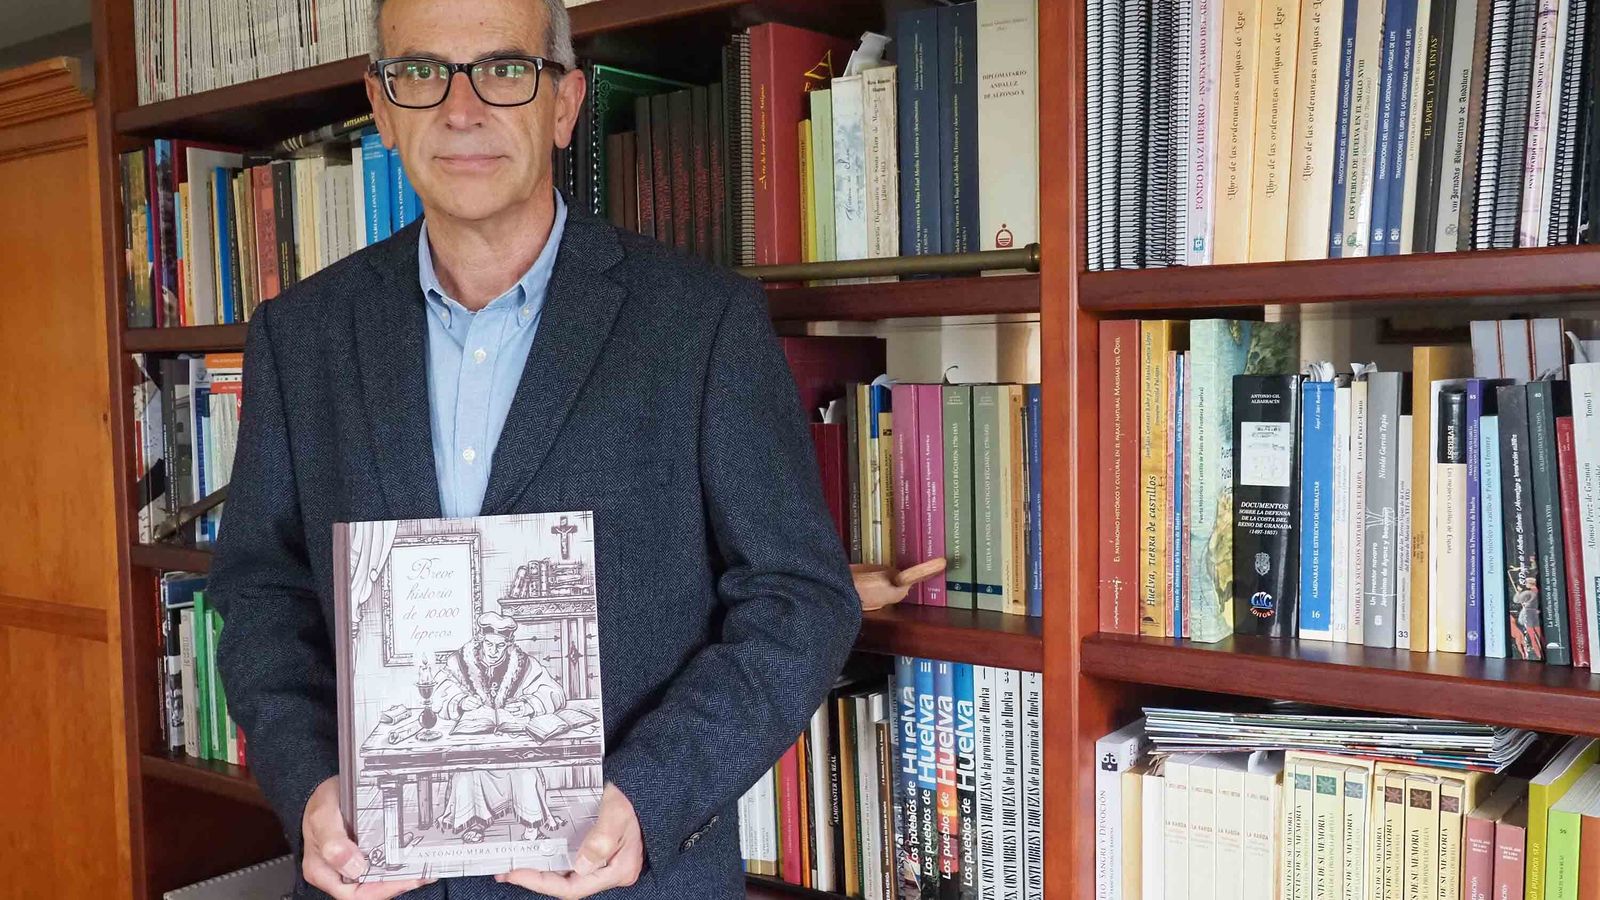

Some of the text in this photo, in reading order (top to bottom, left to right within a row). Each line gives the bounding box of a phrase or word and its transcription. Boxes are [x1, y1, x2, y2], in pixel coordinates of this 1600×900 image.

[1234, 11, 1245, 33] Lepe
[1312, 12, 1320, 22] de
[1234, 36, 1241, 46] de
[1309, 25, 1322, 65] antiguas
[982, 70, 1026, 80] DIPLOMATARIO
[1234, 49, 1244, 88] antiguas
[1265, 6, 1285, 198] Libro de las ordenanzas antiguas de Lepe
[1308, 68, 1316, 122] ordenanzas
[1354, 115, 1360, 125] EN
[1425, 97, 1433, 122] PAPEL
[1304, 125, 1313, 138] las
[1304, 141, 1312, 151] de
[1194, 146, 1204, 171] DÍAZ
[1228, 161, 1236, 171] de
[1302, 154, 1313, 181] Libro
[1352, 158, 1358, 168] DE
[1227, 174, 1238, 200] Libro
[1379, 414, 1388, 431] Tapia
[1241, 502, 1288, 510] DOCUMENTOS
[1582, 462, 1595, 548] Alonso Pérez de Guzmán
[1146, 521, 1155, 531] de
[407, 557, 456, 580] Breve
[407, 583, 453, 600] historia
[1144, 570, 1157, 606] Huelva,
[402, 605, 460, 620] de 10.000
[1312, 610, 1320, 618] 16
[410, 624, 453, 646] leperos
[921, 662, 931, 672] III
[940, 664, 946, 674] II
[978, 687, 989, 712] Huelva
[1000, 691, 1013, 717] Huelva
[1026, 691, 1038, 717] Huelva
[979, 714, 990, 723] de
[1001, 719, 1013, 728] de
[1027, 719, 1038, 728] de
[979, 725, 993, 761] provincia
[1001, 730, 1016, 765] provincia
[1027, 730, 1040, 766] provincia
[900, 686, 919, 863] Los pueblos de Huelva
[917, 693, 935, 876] Los pueblos de Huelva
[980, 771, 991, 780] de
[1002, 776, 1014, 785] de
[1028, 776, 1039, 786] de
[936, 695, 954, 879] Los pueblos de Huelva
[955, 700, 975, 886] Los pueblos de Huelva
[980, 781, 993, 821] RIQUEZAS
[1002, 786, 1016, 826] RIQUEZAS
[1027, 786, 1040, 827] RIQUEZAS
[418, 844, 541, 860] ANTONIO MIRA TOSCANO
[981, 829, 994, 882] COSTUMBRES
[1003, 834, 1016, 888] COSTUMBRES
[1028, 834, 1042, 889] COSTUMBRES
